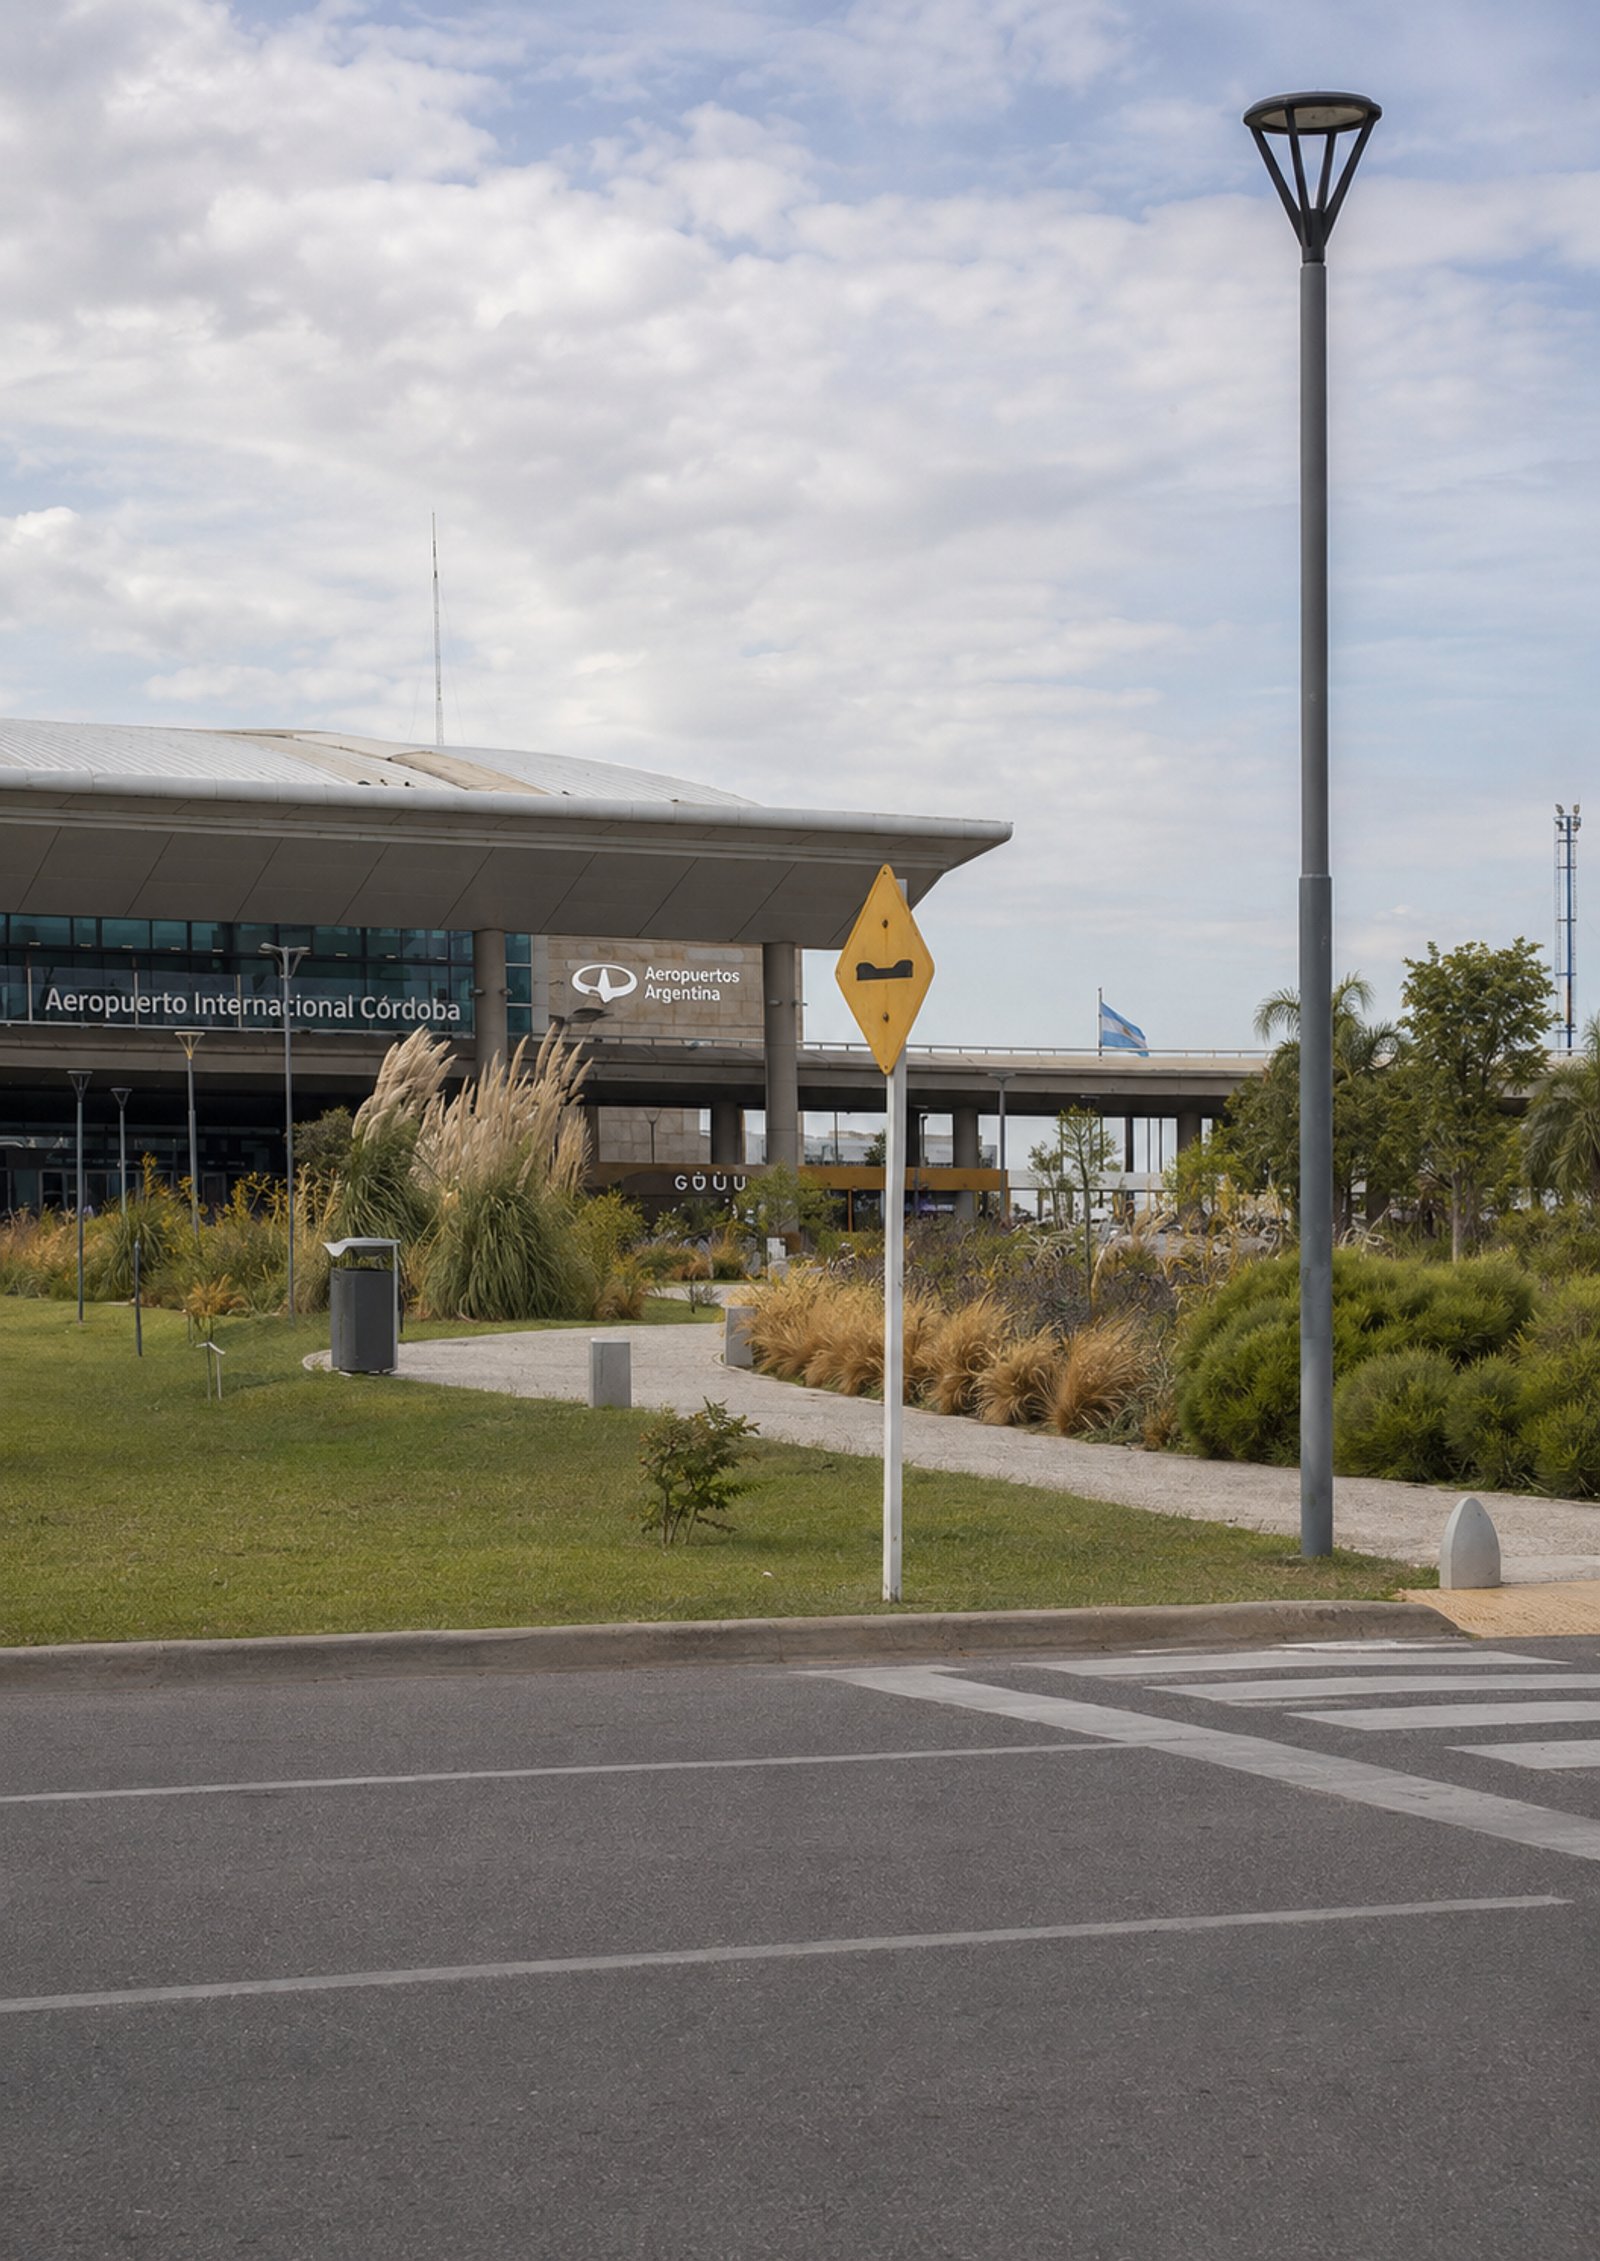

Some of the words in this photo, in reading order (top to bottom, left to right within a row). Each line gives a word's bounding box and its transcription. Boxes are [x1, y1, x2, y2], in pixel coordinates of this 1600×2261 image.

[644, 966, 740, 985] Aeropuertos
[45, 987, 188, 1019] Aeropuerto
[194, 991, 354, 1019] Internacional
[360, 994, 461, 1021] Córdoba
[644, 984, 721, 1004] Argentina
